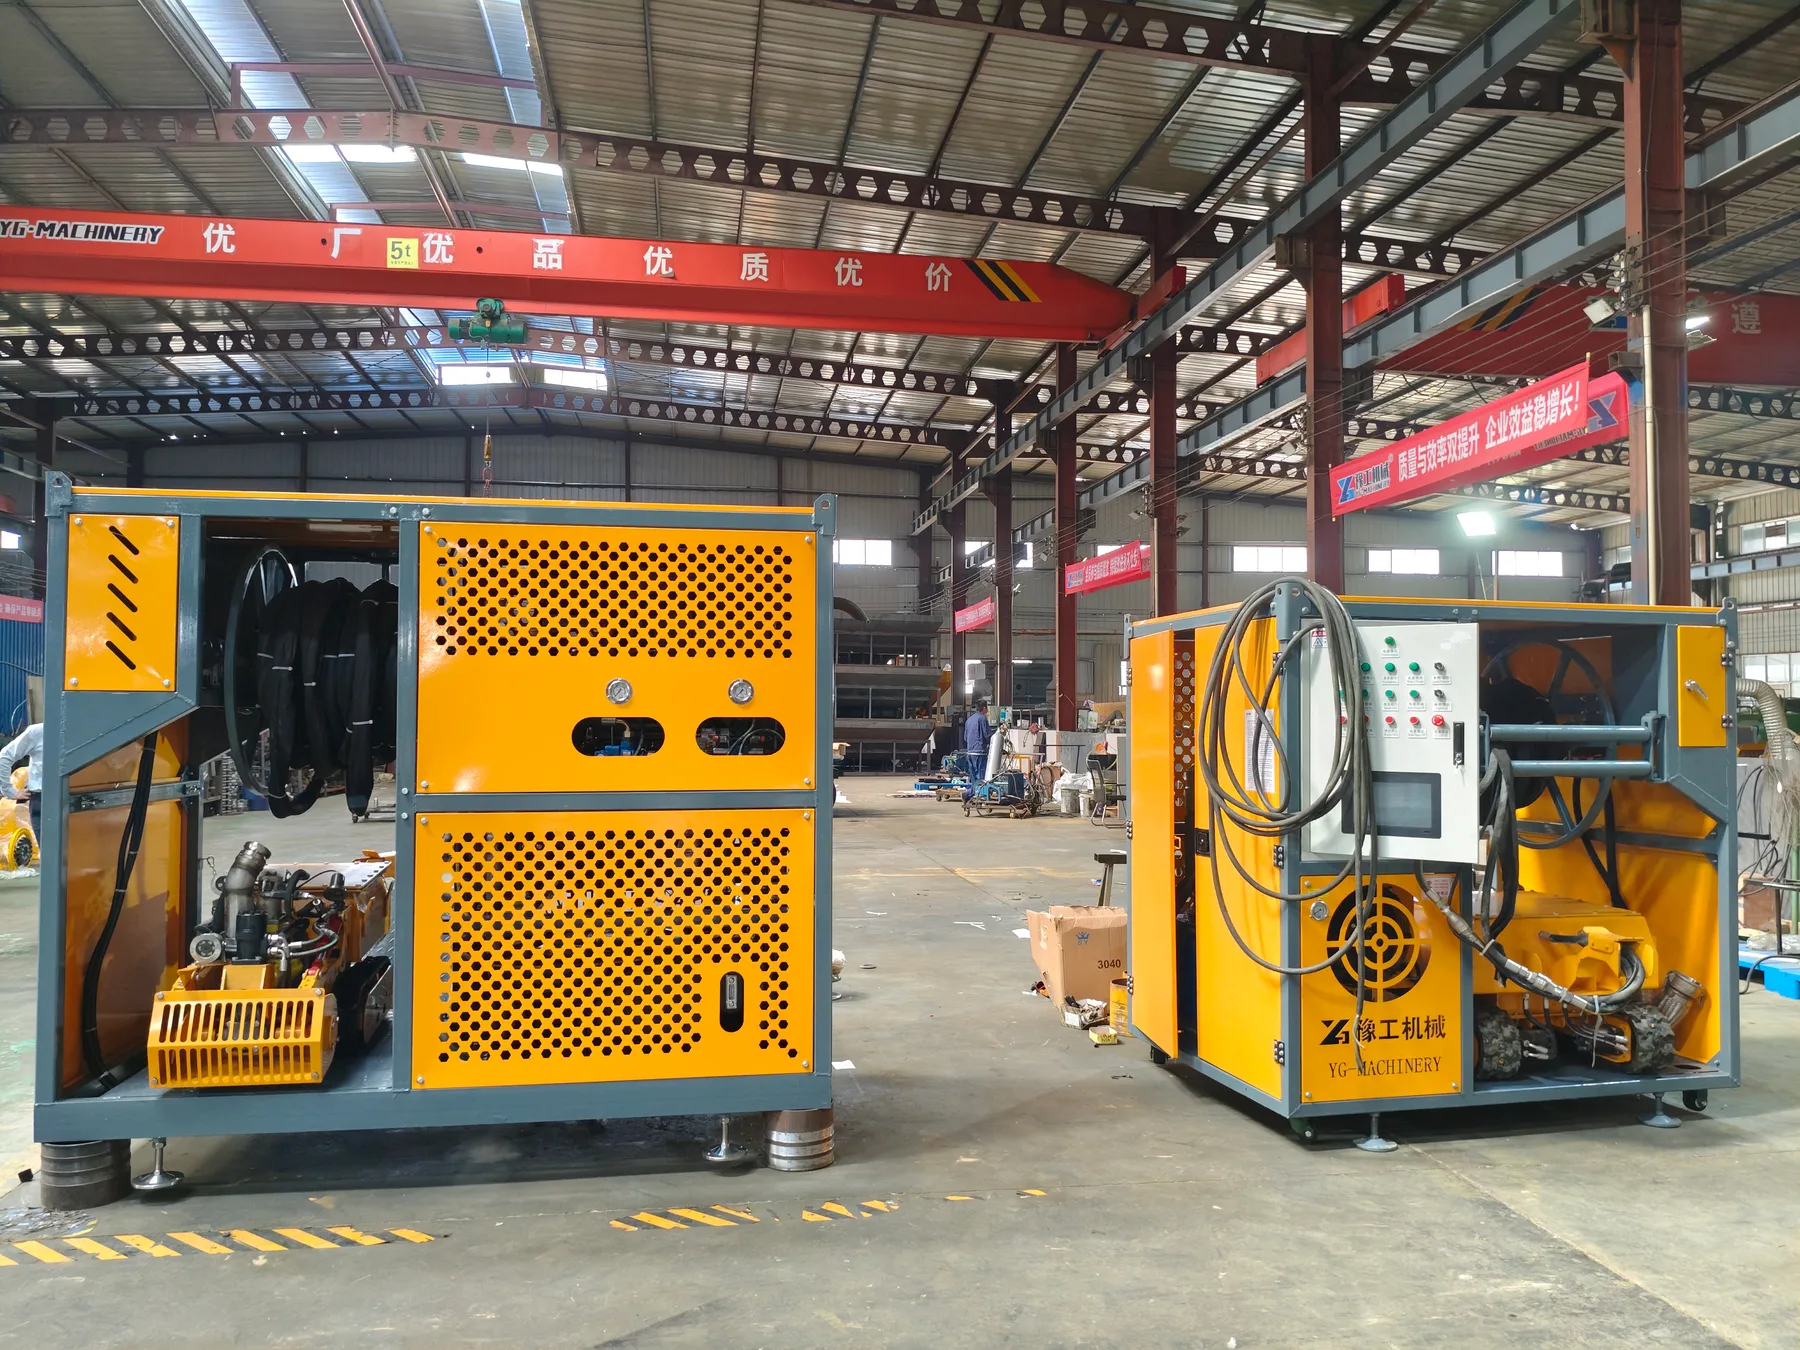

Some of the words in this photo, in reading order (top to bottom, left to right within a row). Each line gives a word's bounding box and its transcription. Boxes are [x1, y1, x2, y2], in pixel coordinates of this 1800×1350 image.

[1398, 421, 1480, 482] 质量与效率双提升
[1097, 959, 1121, 969] 3040
